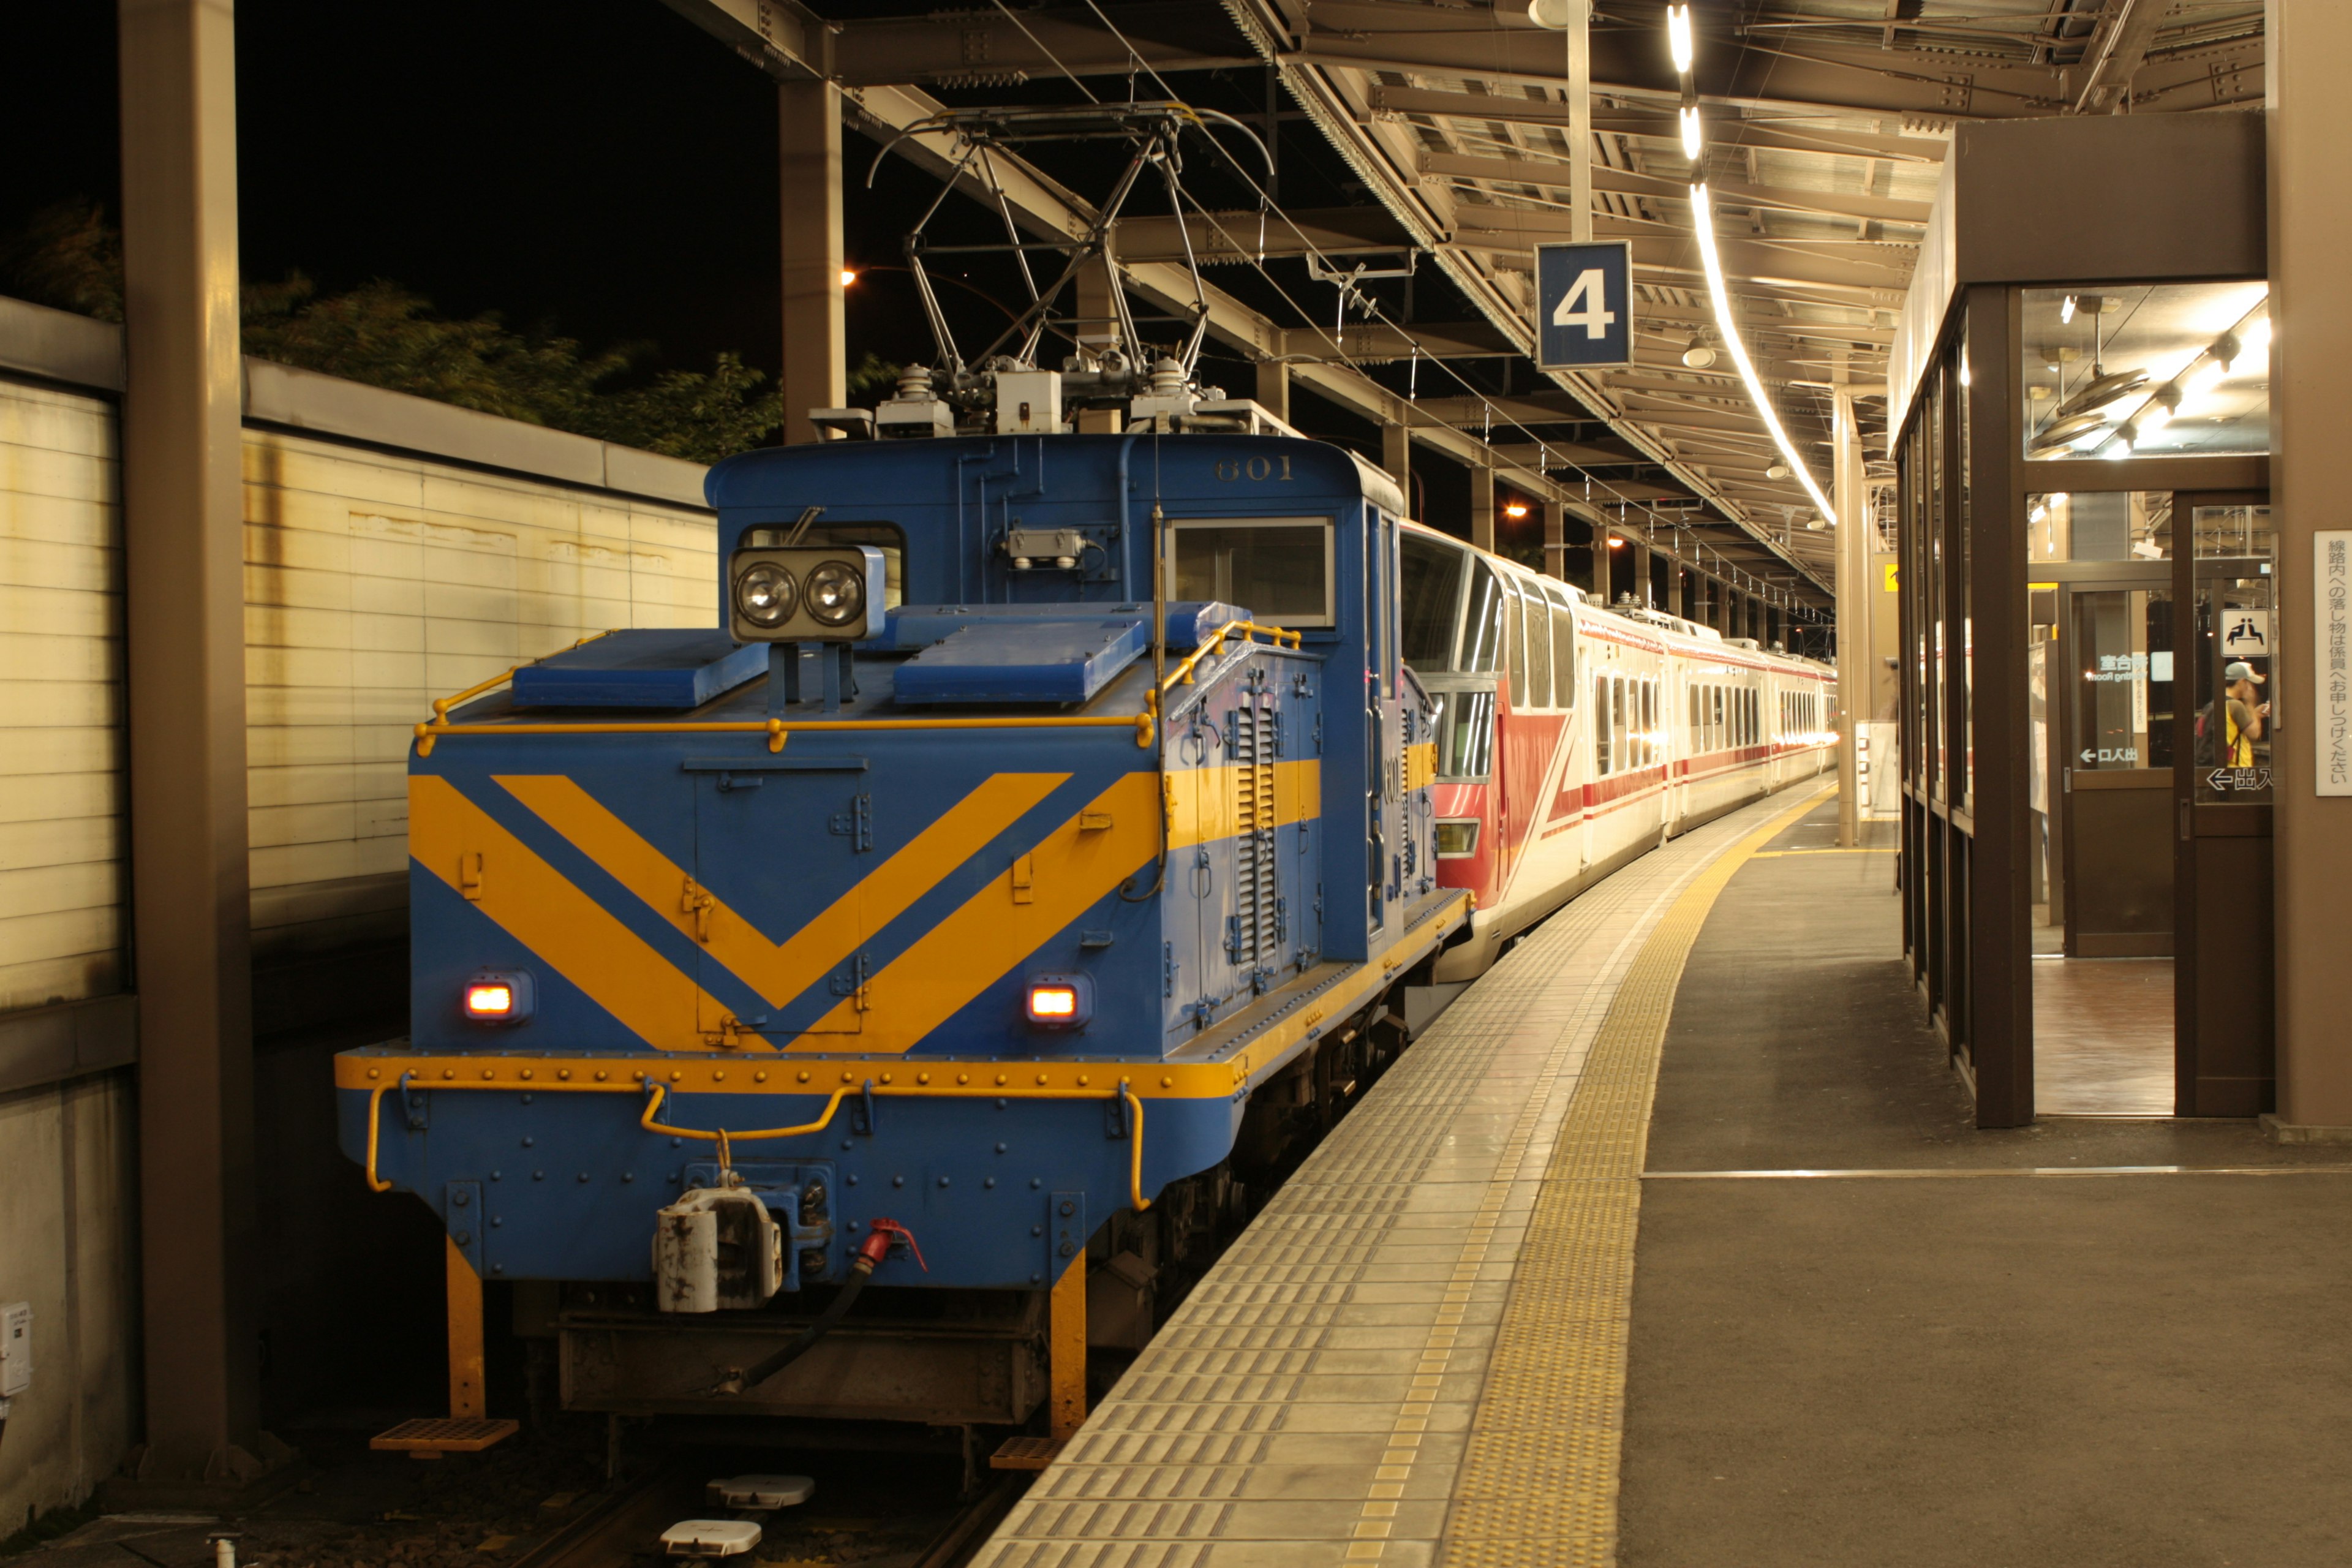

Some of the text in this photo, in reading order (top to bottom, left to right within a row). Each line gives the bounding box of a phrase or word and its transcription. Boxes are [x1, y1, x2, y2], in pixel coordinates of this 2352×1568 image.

[1553, 268, 1615, 339] 4
[1215, 455, 1294, 482] 601
[2329, 540, 2346, 784] 線路内への落し物は係員へお申しつけください
